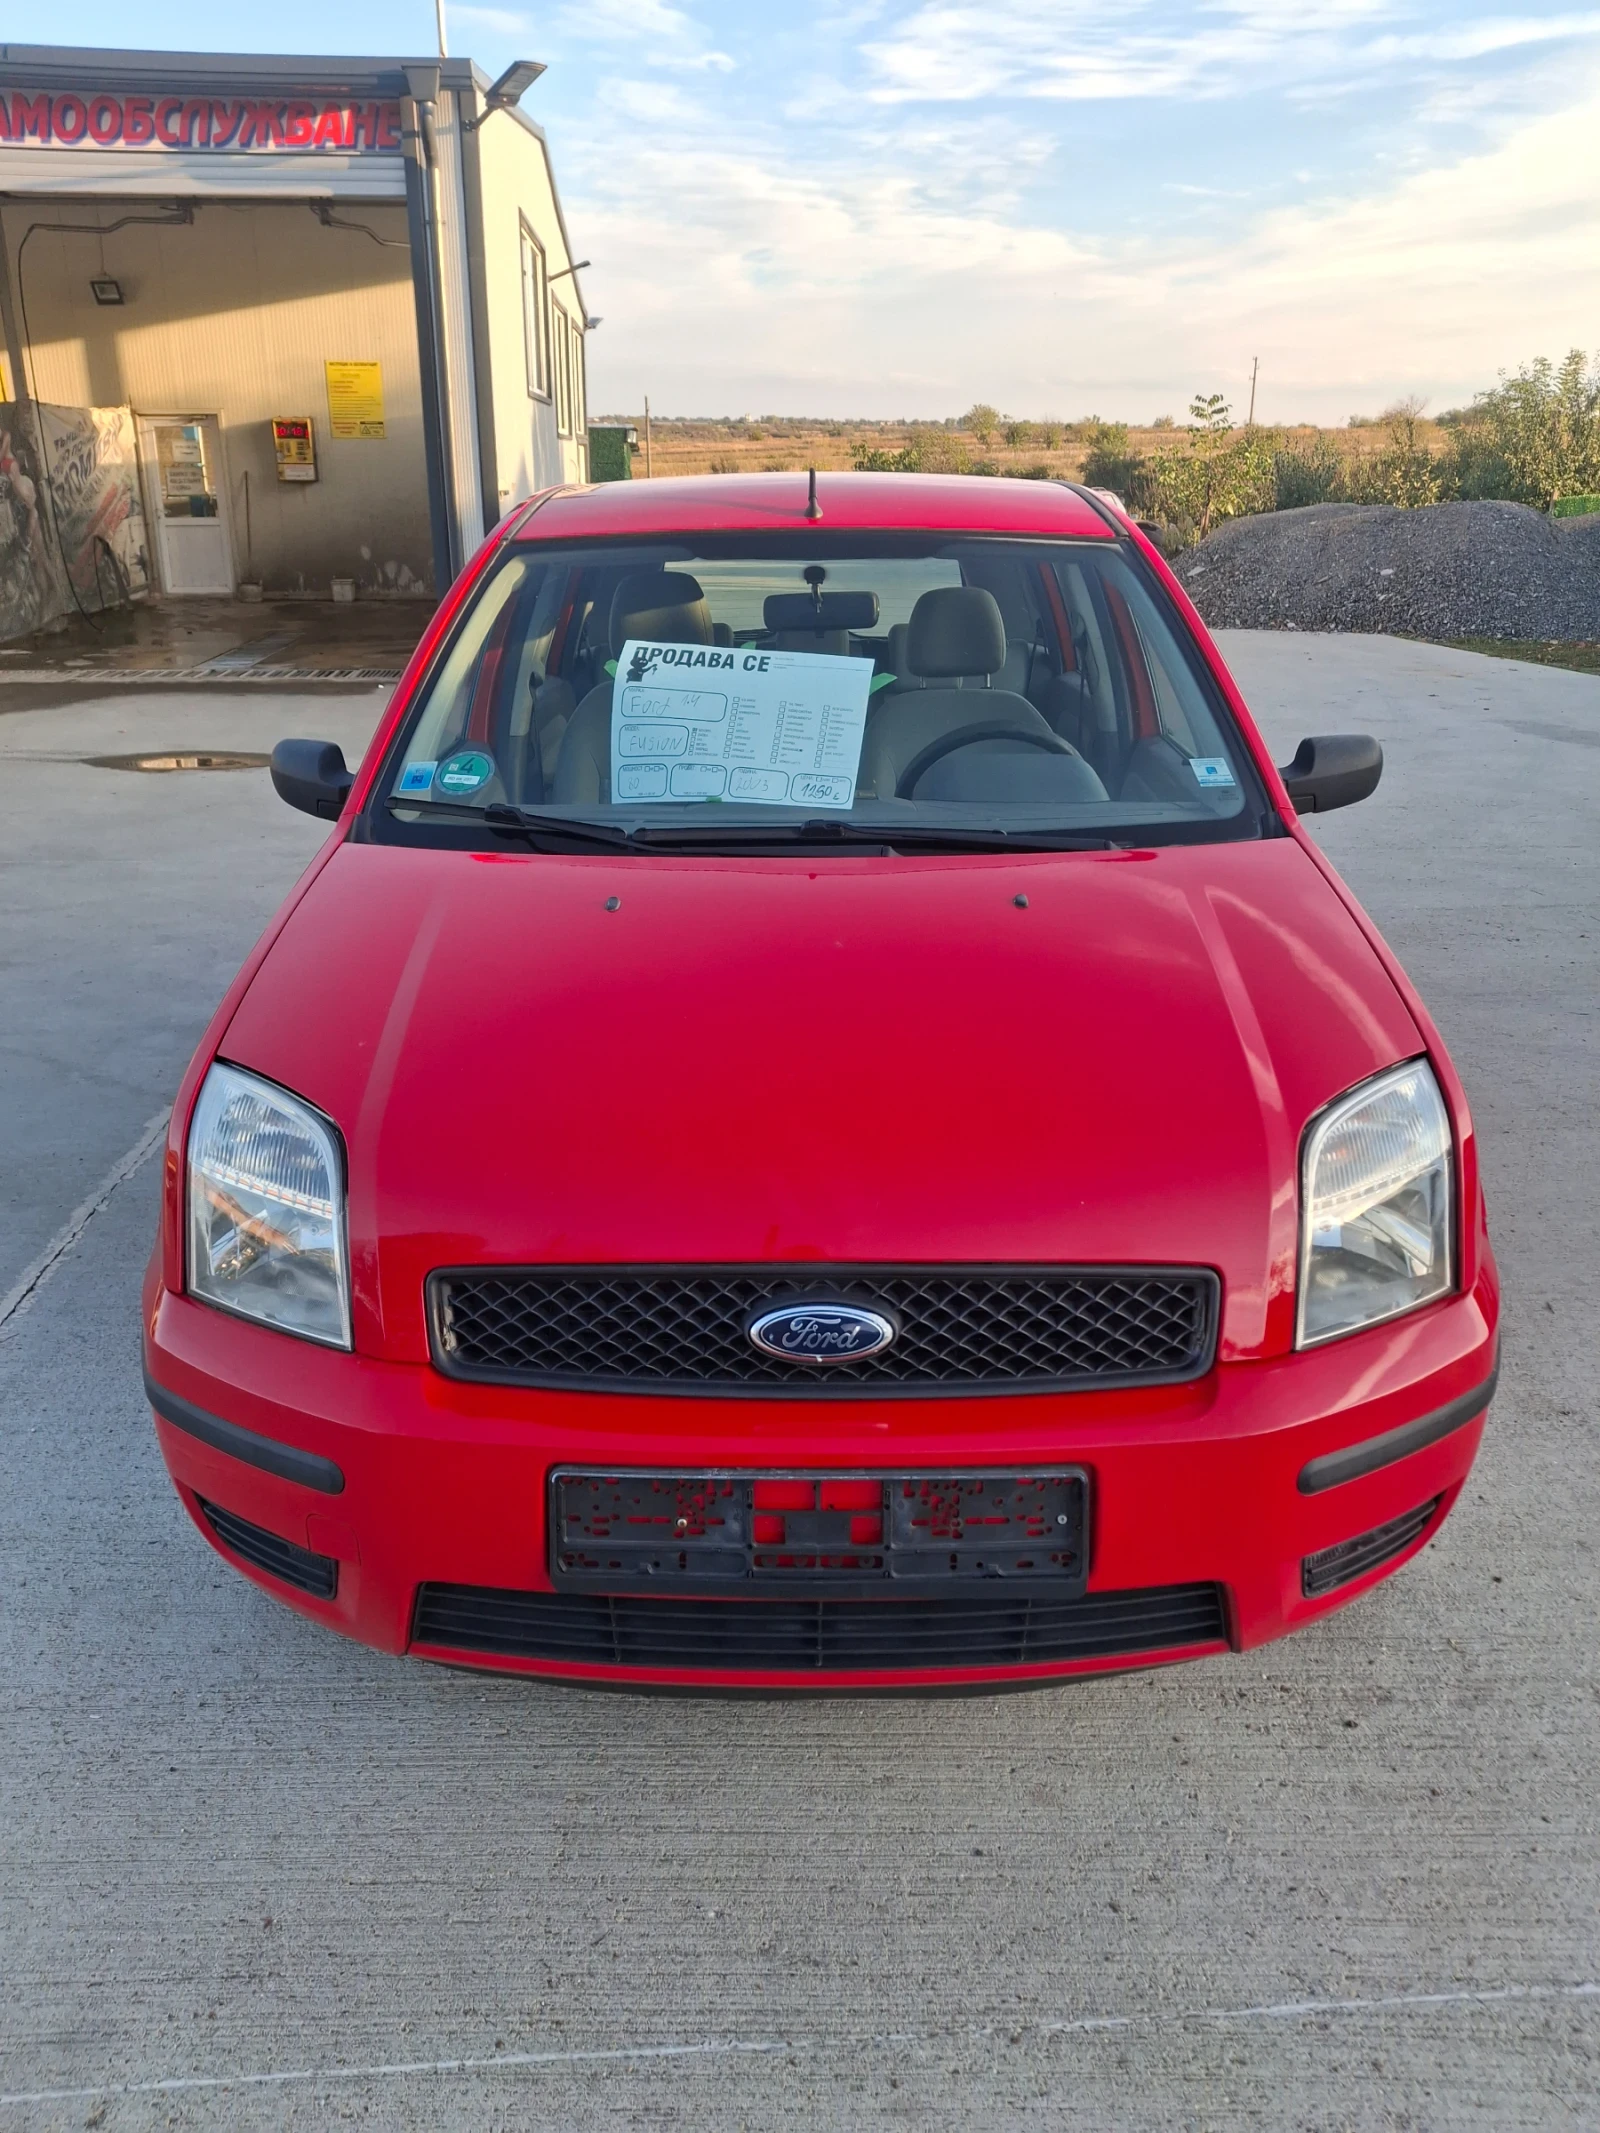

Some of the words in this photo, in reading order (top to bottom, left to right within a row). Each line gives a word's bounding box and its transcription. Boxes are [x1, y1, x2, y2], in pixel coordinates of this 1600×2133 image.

[635, 646, 735, 670] ПРОДАВА
[742, 655, 772, 673] СЕ
[681, 693, 702, 707] 1.4
[460, 757, 475, 773] 4
[735, 776, 769, 792] 2003
[782, 1316, 861, 1349] Ford
